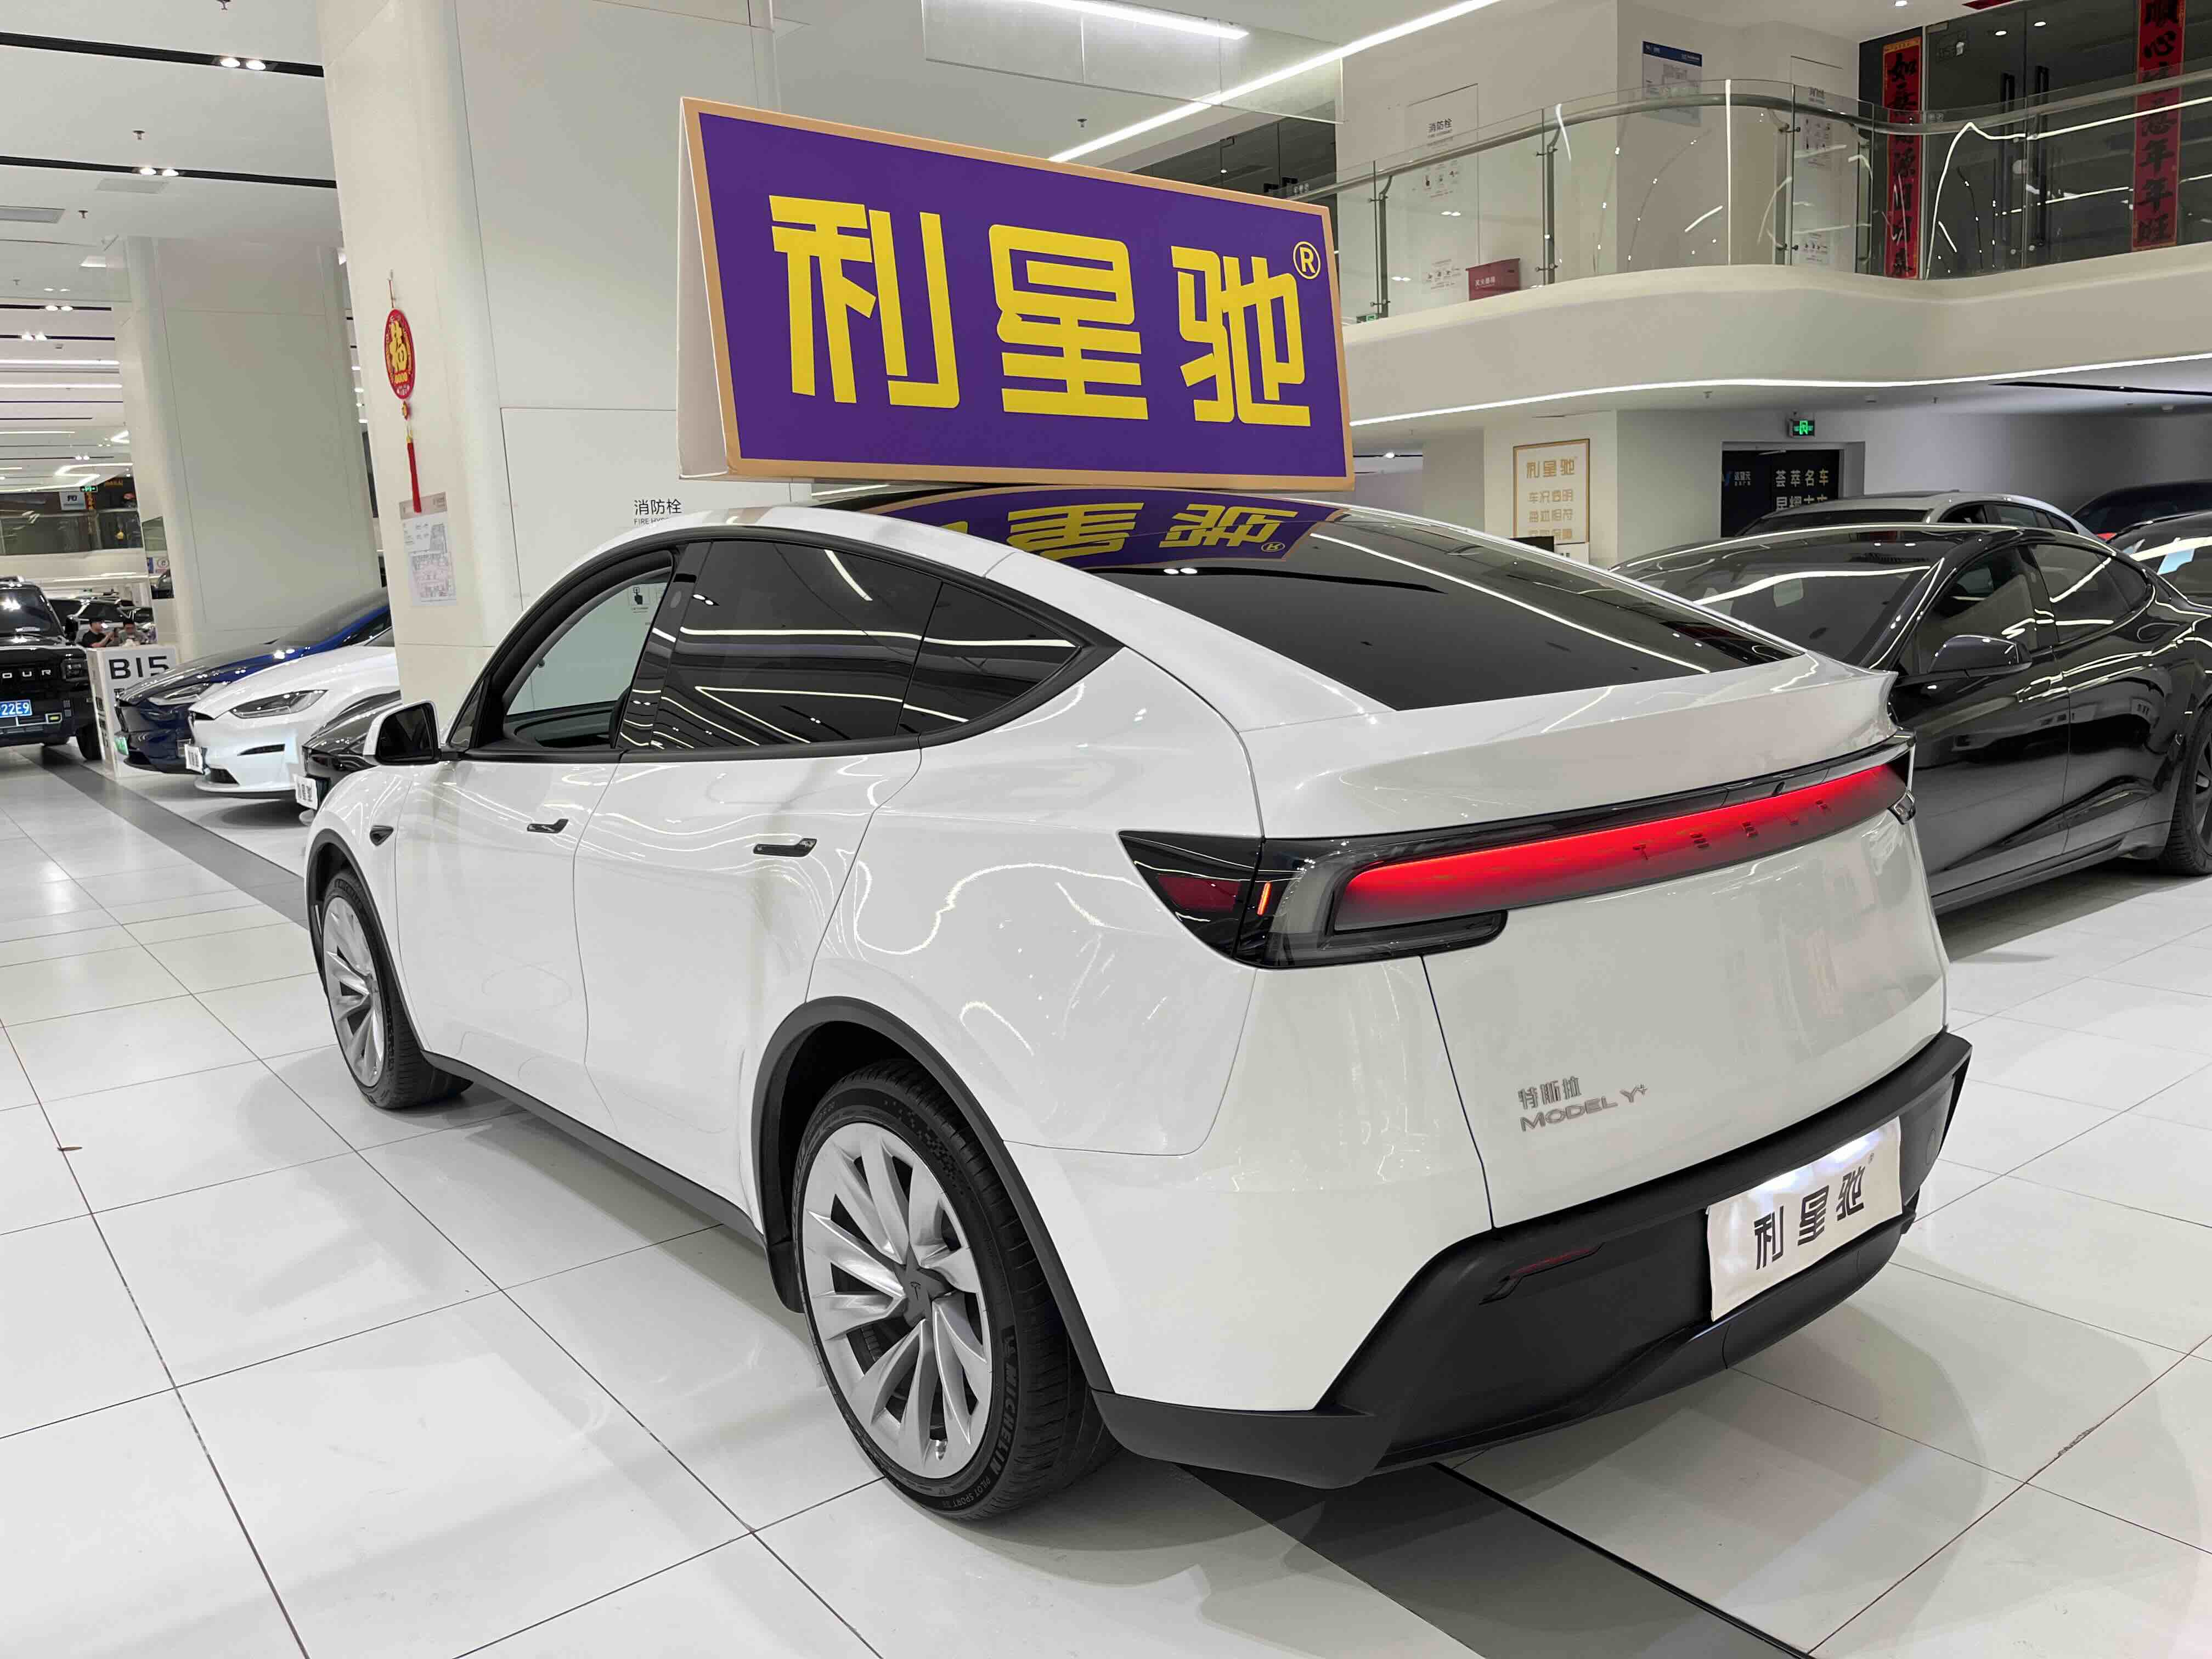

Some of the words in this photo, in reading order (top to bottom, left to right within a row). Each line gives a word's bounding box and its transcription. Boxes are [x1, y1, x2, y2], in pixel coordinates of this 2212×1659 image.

[1775, 469, 1829, 487] 荟萃名车
[634, 498, 682, 515] 消防栓
[0, 702, 30, 715] 22E9
[1520, 1096, 1618, 1132] MODEL
[989, 1363, 1017, 1475] MICHELIN
